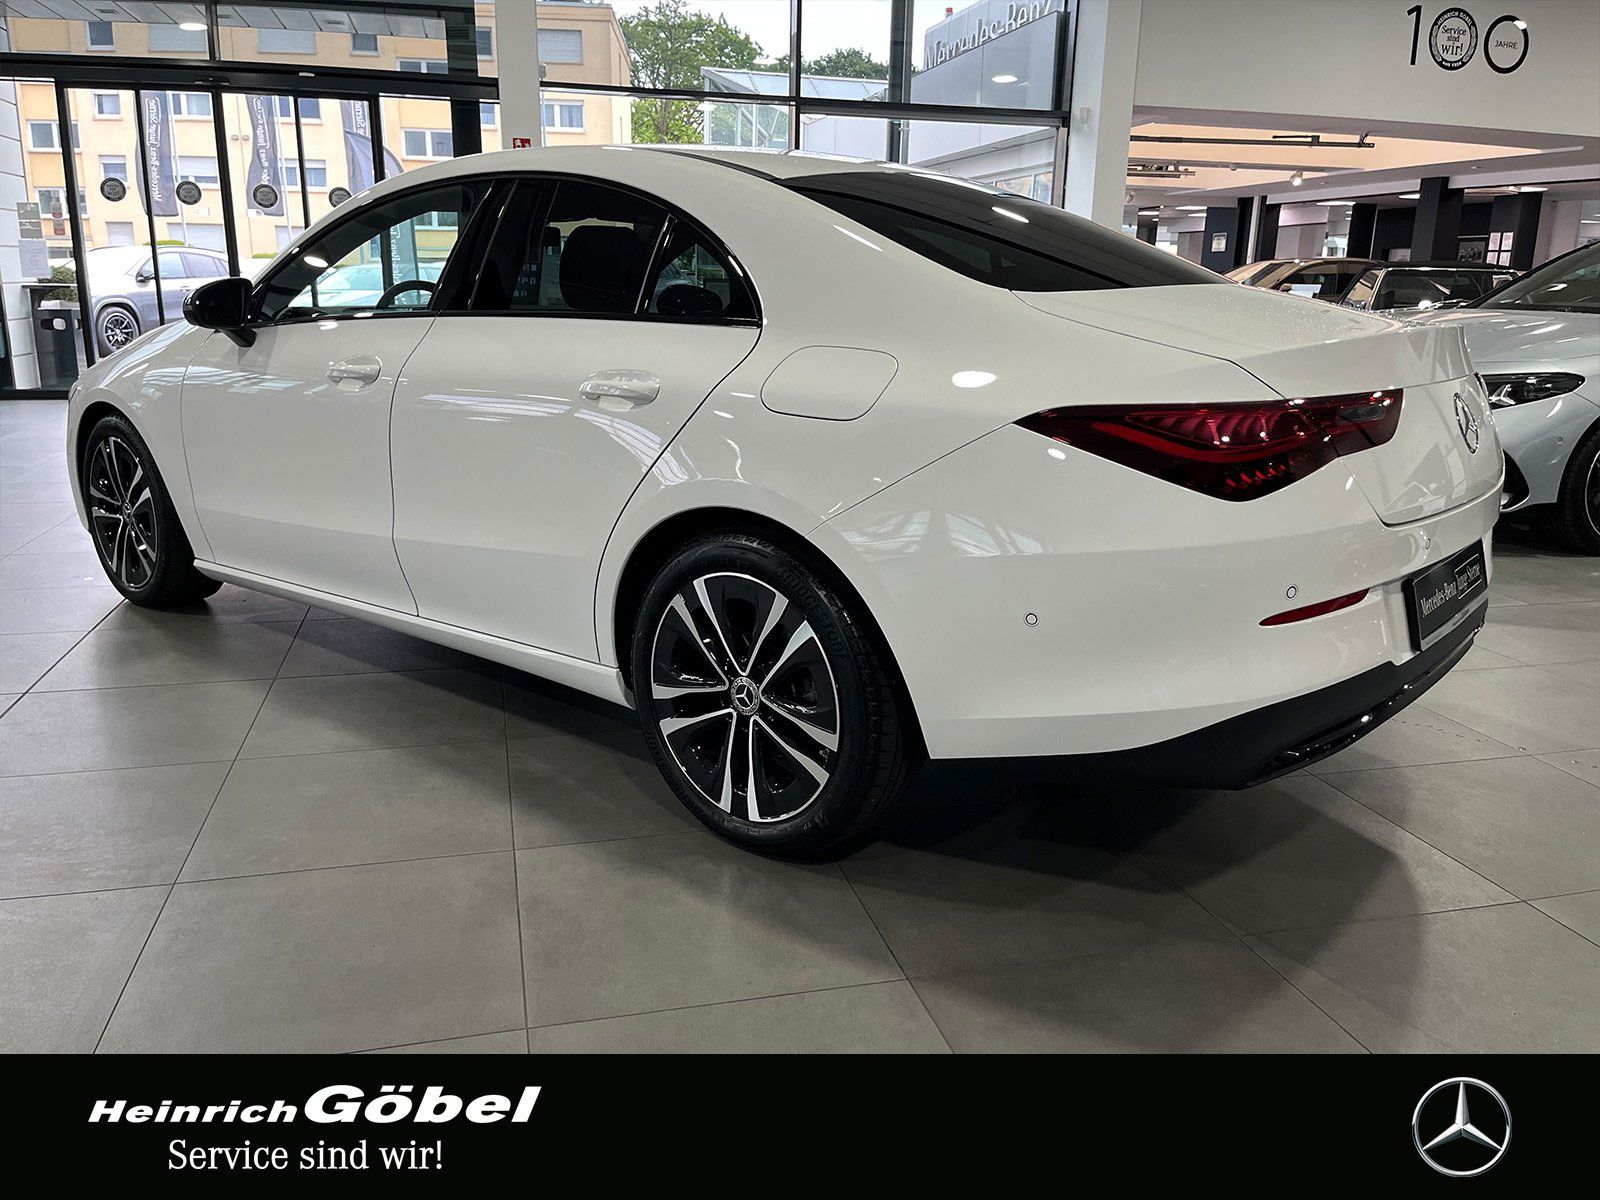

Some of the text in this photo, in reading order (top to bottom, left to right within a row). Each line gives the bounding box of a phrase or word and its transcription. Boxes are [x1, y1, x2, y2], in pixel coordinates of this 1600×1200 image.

[1441, 25, 1467, 36] Service
[1446, 34, 1460, 42] sind
[1441, 42, 1464, 56] wir!
[1494, 40, 1519, 49] JAHRE
